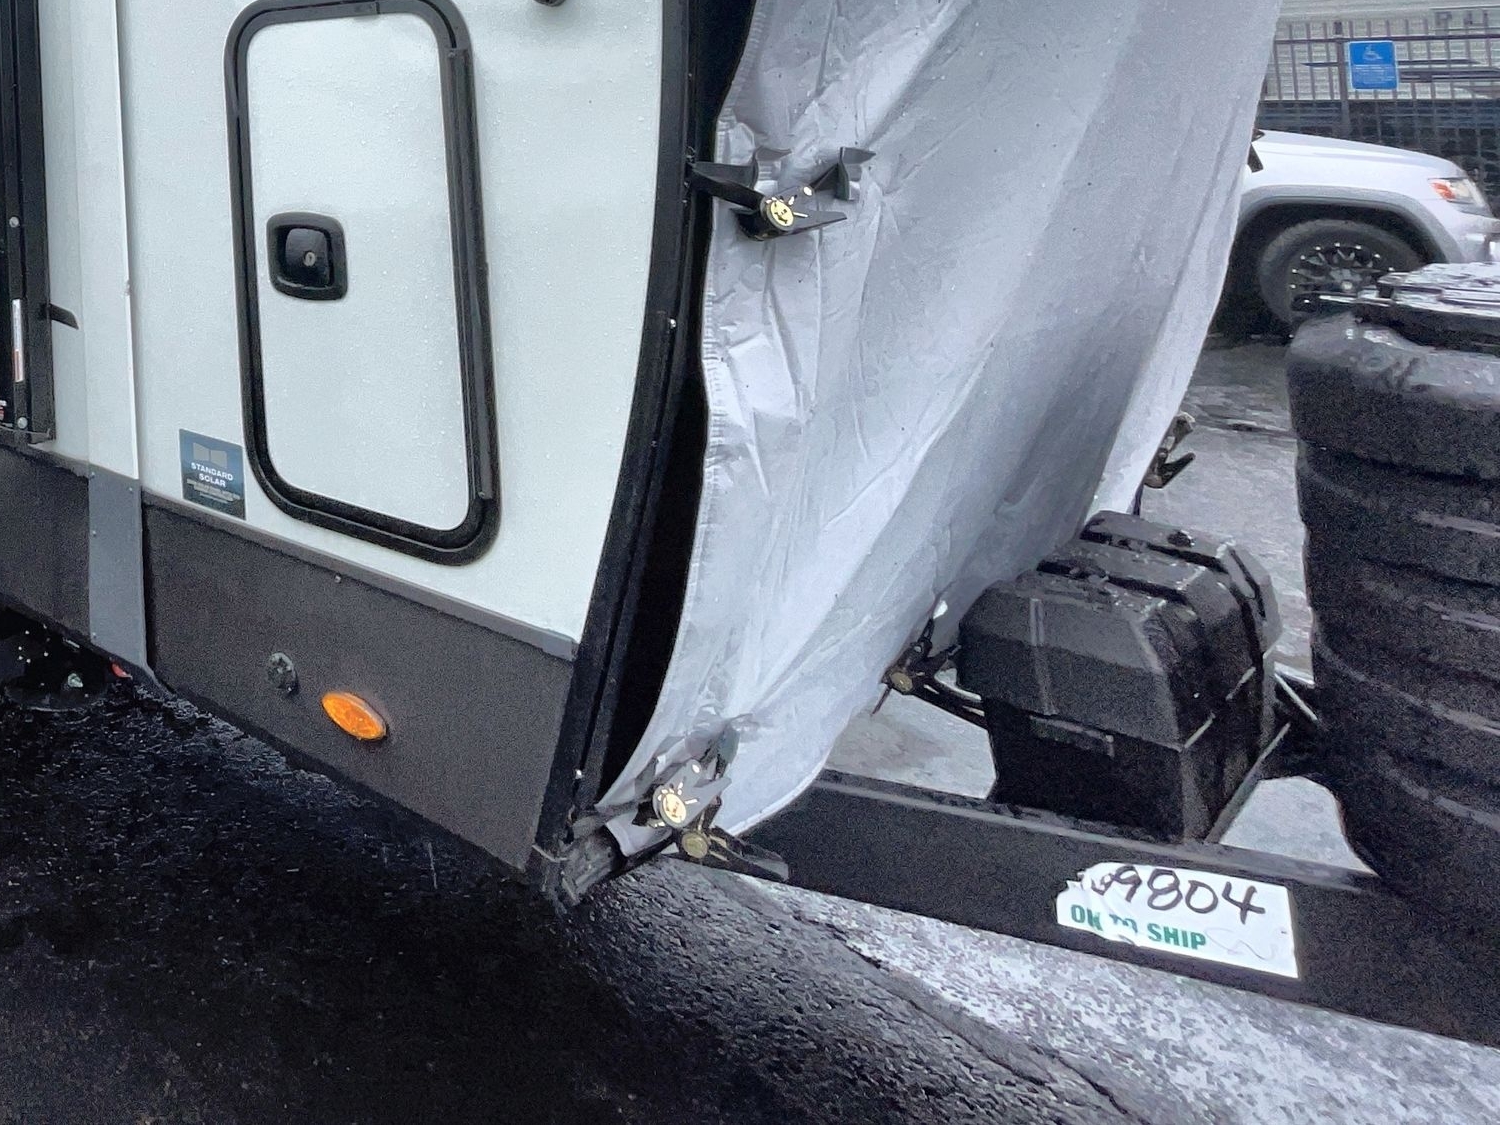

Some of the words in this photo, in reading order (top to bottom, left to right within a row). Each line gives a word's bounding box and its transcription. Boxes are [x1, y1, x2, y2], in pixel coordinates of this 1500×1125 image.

[191, 462, 234, 481] STANDARD
[199, 473, 226, 488] SOLAR
[1147, 923, 1206, 951] SHIP
